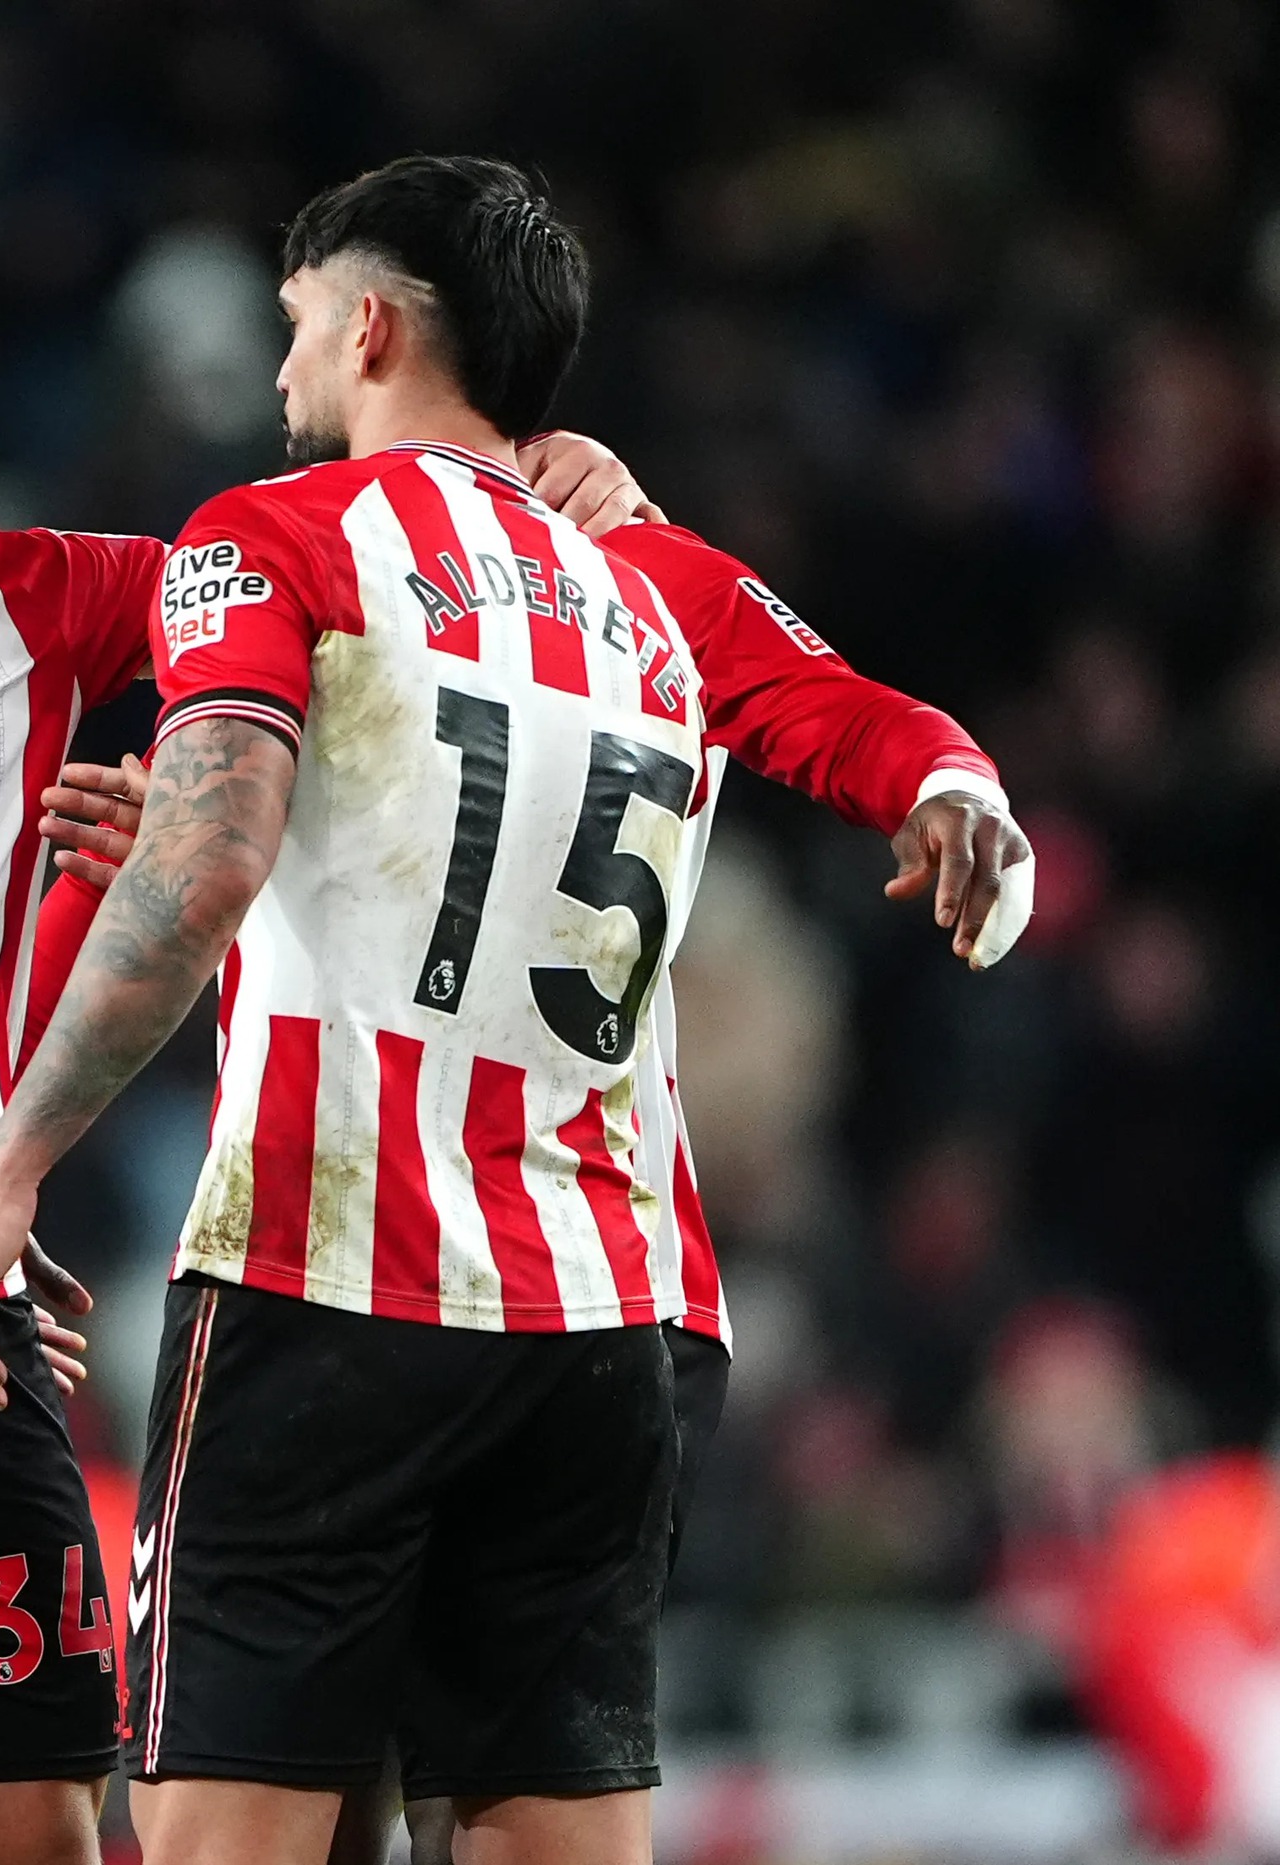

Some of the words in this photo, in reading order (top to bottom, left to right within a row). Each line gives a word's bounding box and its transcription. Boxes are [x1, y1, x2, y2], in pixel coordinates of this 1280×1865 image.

[166, 545, 234, 586] Live
[165, 576, 265, 621] Score
[167, 608, 216, 655] Bet
[404, 551, 689, 710] ALDERETE
[412, 685, 696, 1065] 15
